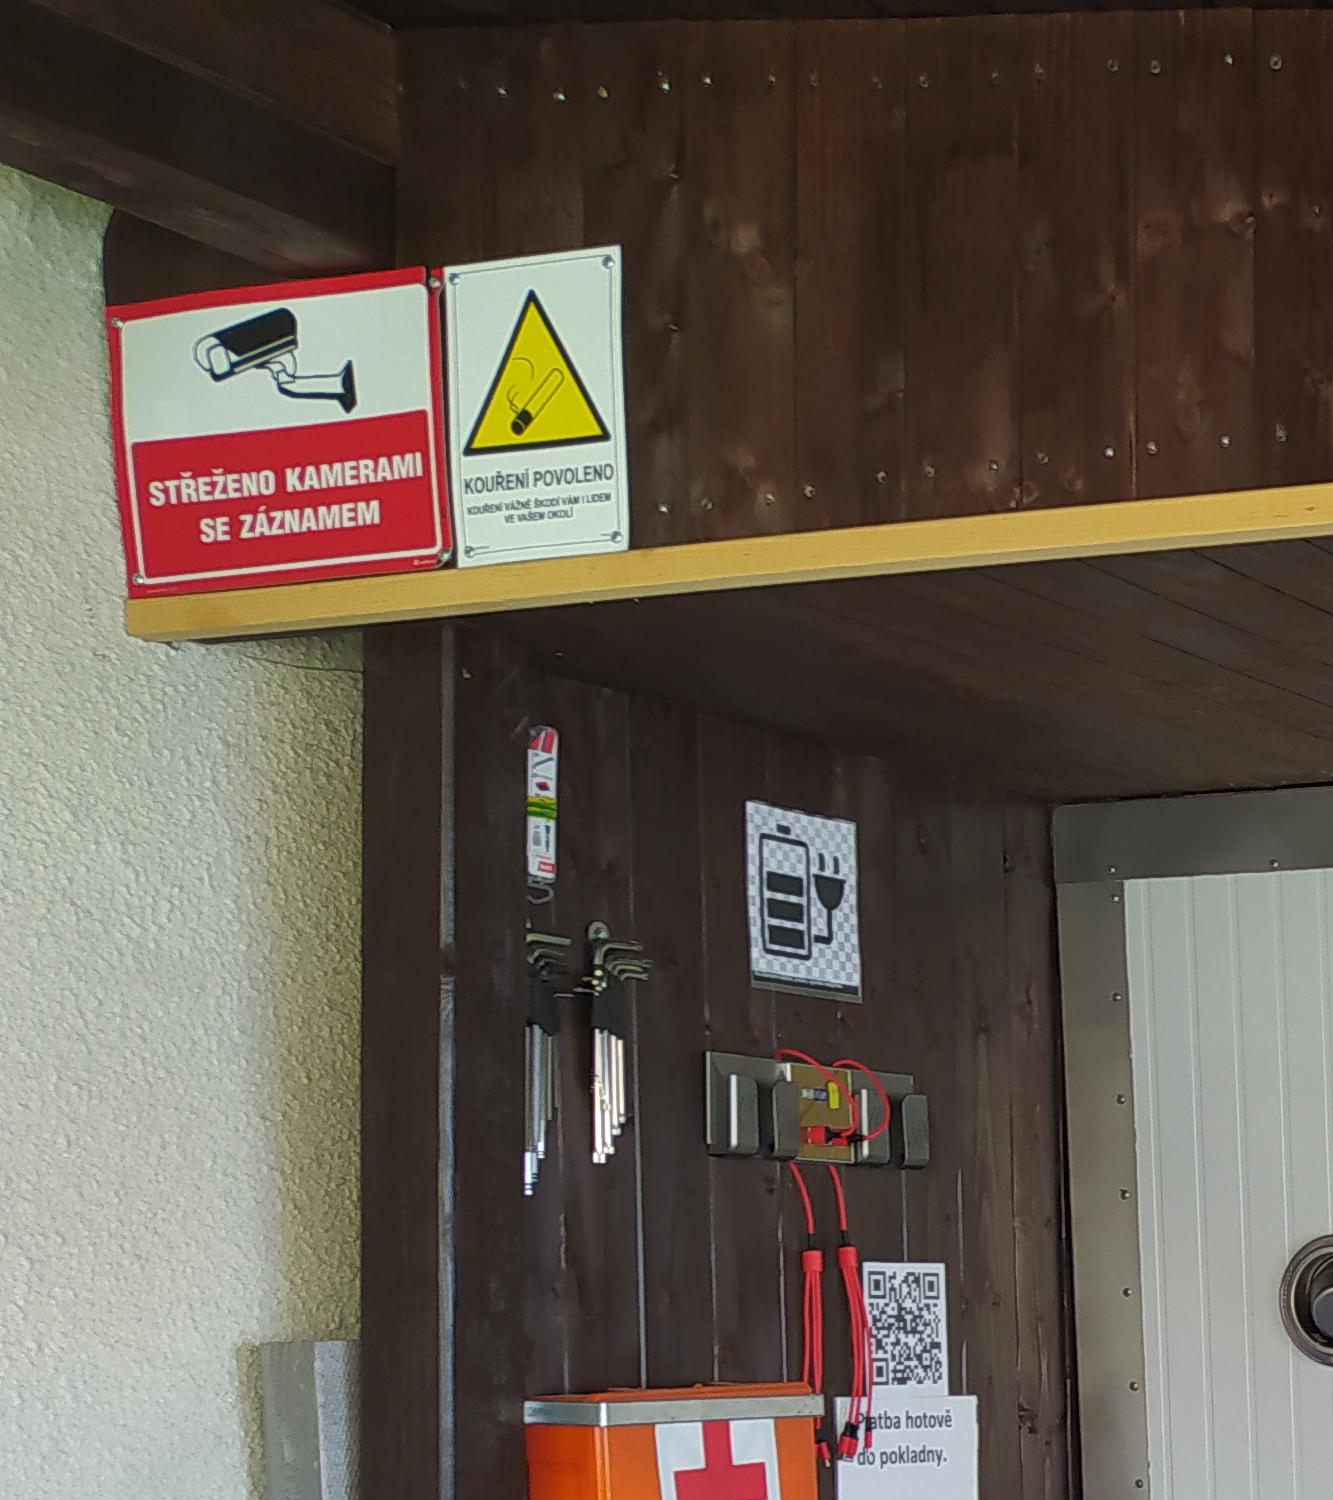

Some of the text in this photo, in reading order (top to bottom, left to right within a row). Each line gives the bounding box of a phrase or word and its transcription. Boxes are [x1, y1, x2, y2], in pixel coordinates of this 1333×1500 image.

[149, 452, 423, 506] STŘEŽENO KAMERAMI
[464, 464, 614, 494] KOUŘENÍ POVOLENO
[562, 495, 579, 505] VÁM
[200, 500, 381, 542] SE ZÁZNAMEM
[505, 514, 515, 523] VE
[858, 1409, 952, 1430] Patba hotově
[857, 1445, 947, 1469] do pokladny.
